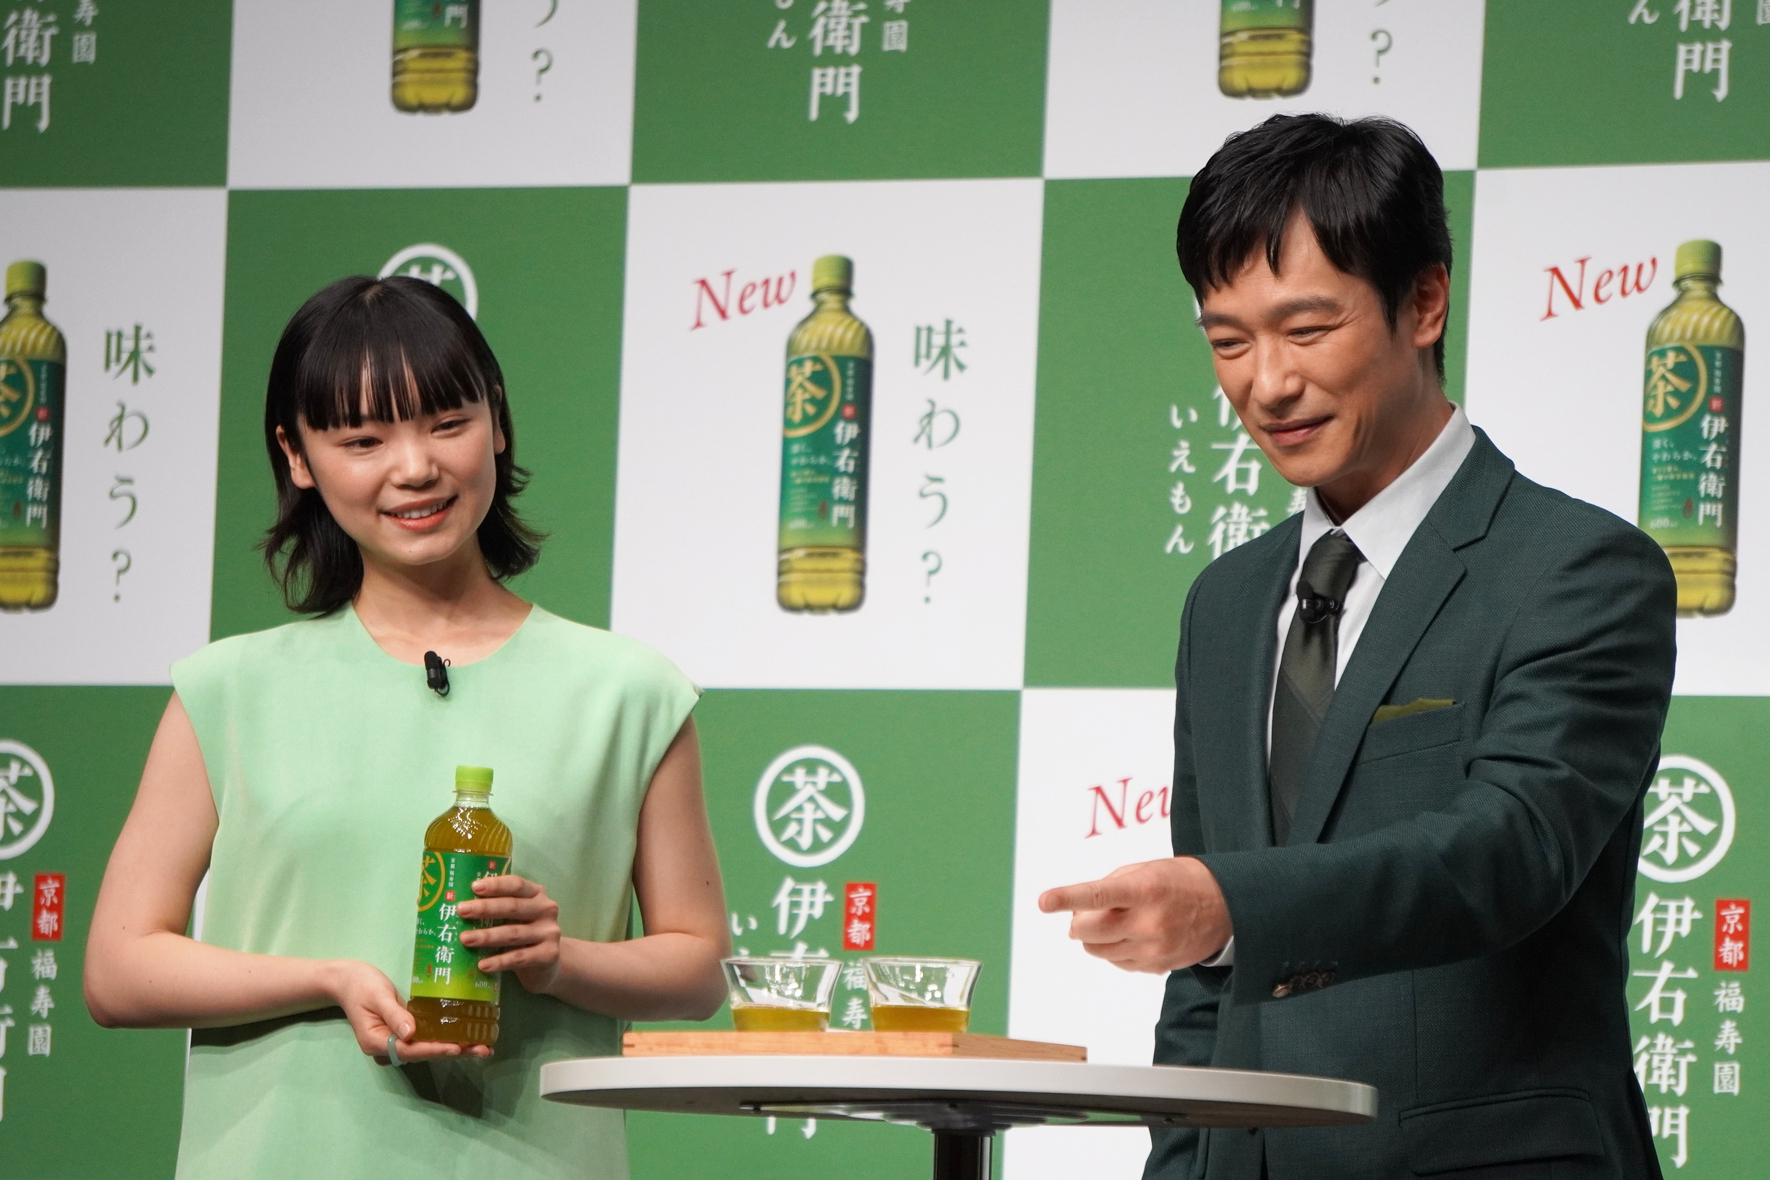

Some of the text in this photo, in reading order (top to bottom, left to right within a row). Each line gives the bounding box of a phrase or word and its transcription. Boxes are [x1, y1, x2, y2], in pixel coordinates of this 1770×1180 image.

[690, 269, 797, 331] New
[1540, 255, 1659, 322] New
[784, 360, 828, 423] 茶
[1646, 351, 1692, 417] 茶
[27, 421, 51, 529] 伊右衛門
[831, 420, 860, 529] 伊右衛門
[1165, 404, 1198, 554] いえもん
[1698, 413, 1729, 528] 伊右衛門
[774, 766, 849, 851] 茶
[1642, 776, 1718, 866] 茶
[434, 903, 457, 985] 伊右衛門
[770, 876, 835, 960] 伊
[848, 886, 873, 948] 京都
[28, 879, 59, 1057] 京都 福寿園
[1713, 902, 1745, 1096] 京都 福寿園
[1632, 891, 1703, 1169] 伊右衛門
